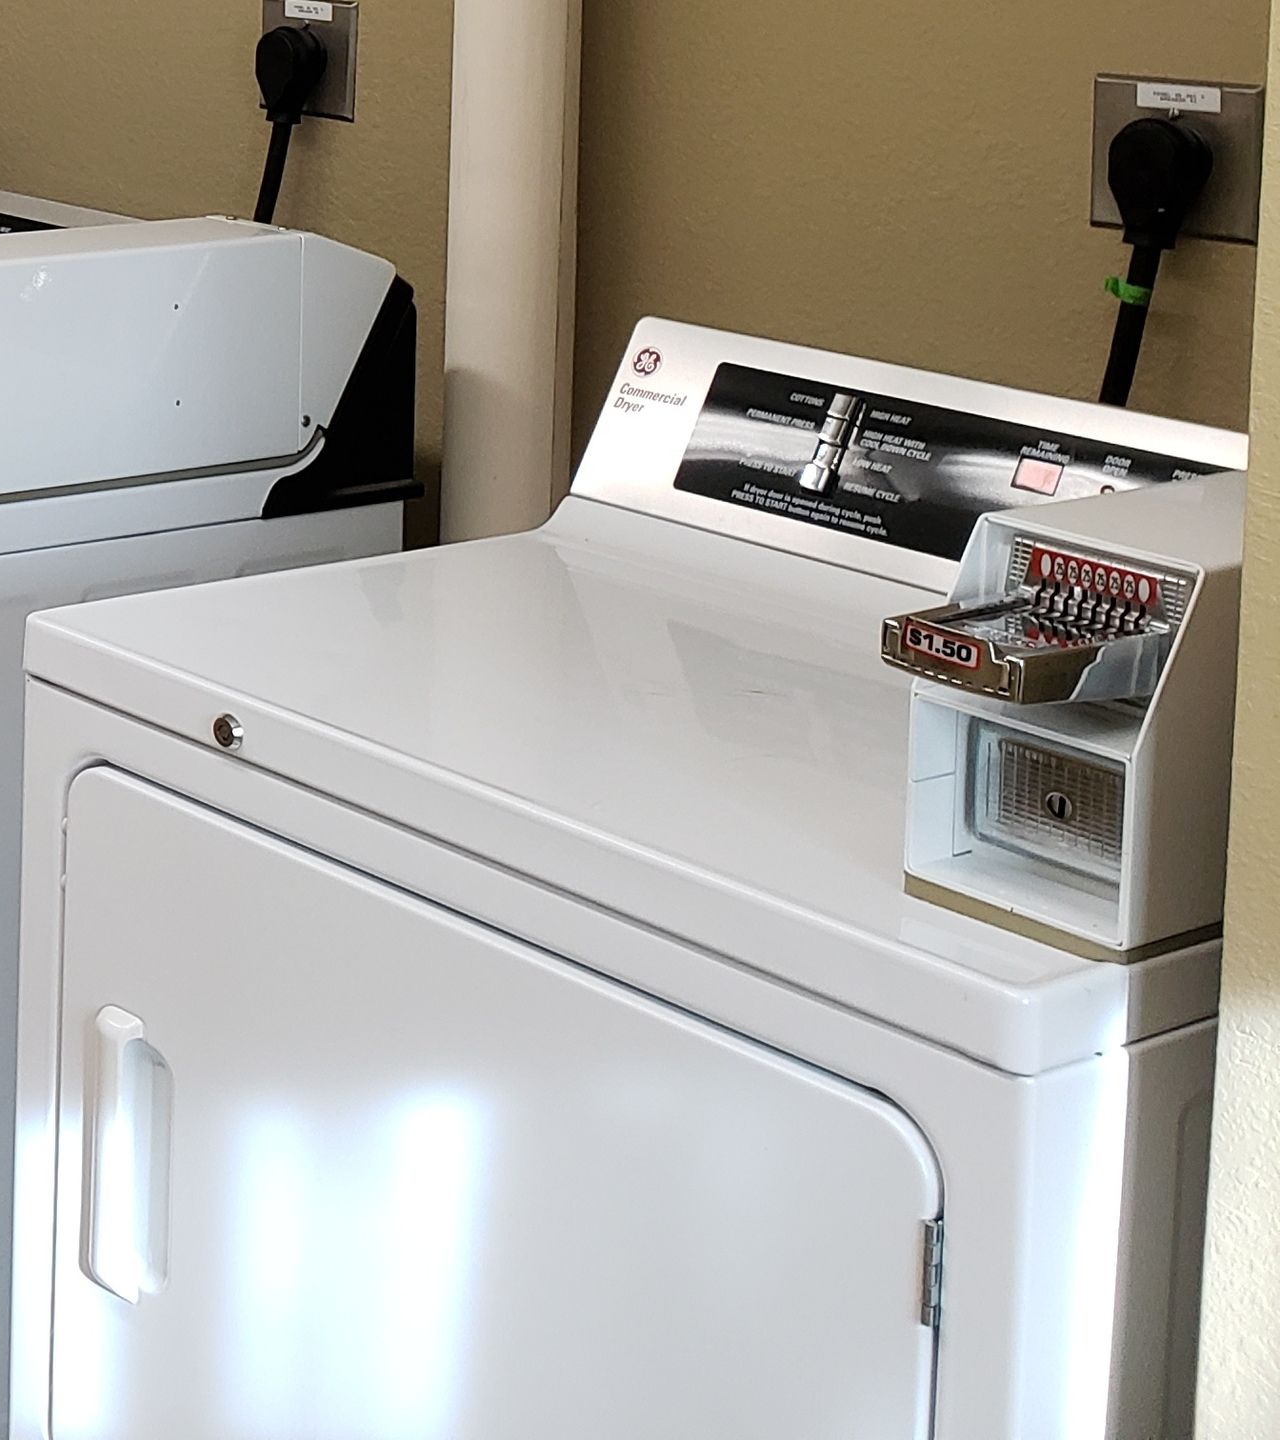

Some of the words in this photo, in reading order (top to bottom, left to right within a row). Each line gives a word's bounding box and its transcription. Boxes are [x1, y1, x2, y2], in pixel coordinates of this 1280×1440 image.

[620, 382, 687, 406] Commercial
[790, 393, 825, 407] COTTONS
[613, 397, 644, 413] Dryer
[746, 408, 792, 425] PERMANENT
[791, 417, 816, 430] PRESS
[870, 411, 890, 422] HIGH
[890, 415, 912, 425] HEAT
[860, 439, 880, 450] COOL
[880, 443, 907, 456] DOWN
[907, 449, 932, 461] CYCLE
[863, 430, 884, 441] HIGH
[883, 434, 903, 445] HEAT
[904, 438, 926, 450] WITH
[1038, 440, 1060, 452] TIME
[1020, 446, 1070, 464] REMAINING
[1105, 455, 1131, 467] DOOR
[870, 461, 893, 473] HEAT
[1102, 465, 1128, 477] OPEN
[749, 485, 767, 498] dryer
[768, 489, 783, 500] door
[792, 496, 818, 509] opened
[818, 501, 840, 516] during
[843, 482, 874, 498] RESUME
[875, 490, 900, 503] CYCLE
[731, 490, 754, 503] PRESS
[755, 495, 765, 506] TO
[765, 497, 788, 511] START
[810, 510, 829, 524] again
[1056, 562, 1064, 576] 25
[1070, 566, 1077, 580] 25
[1110, 576, 1119, 590] 25
[1125, 580, 1133, 594] 25
[909, 626, 972, 662] $1.50
